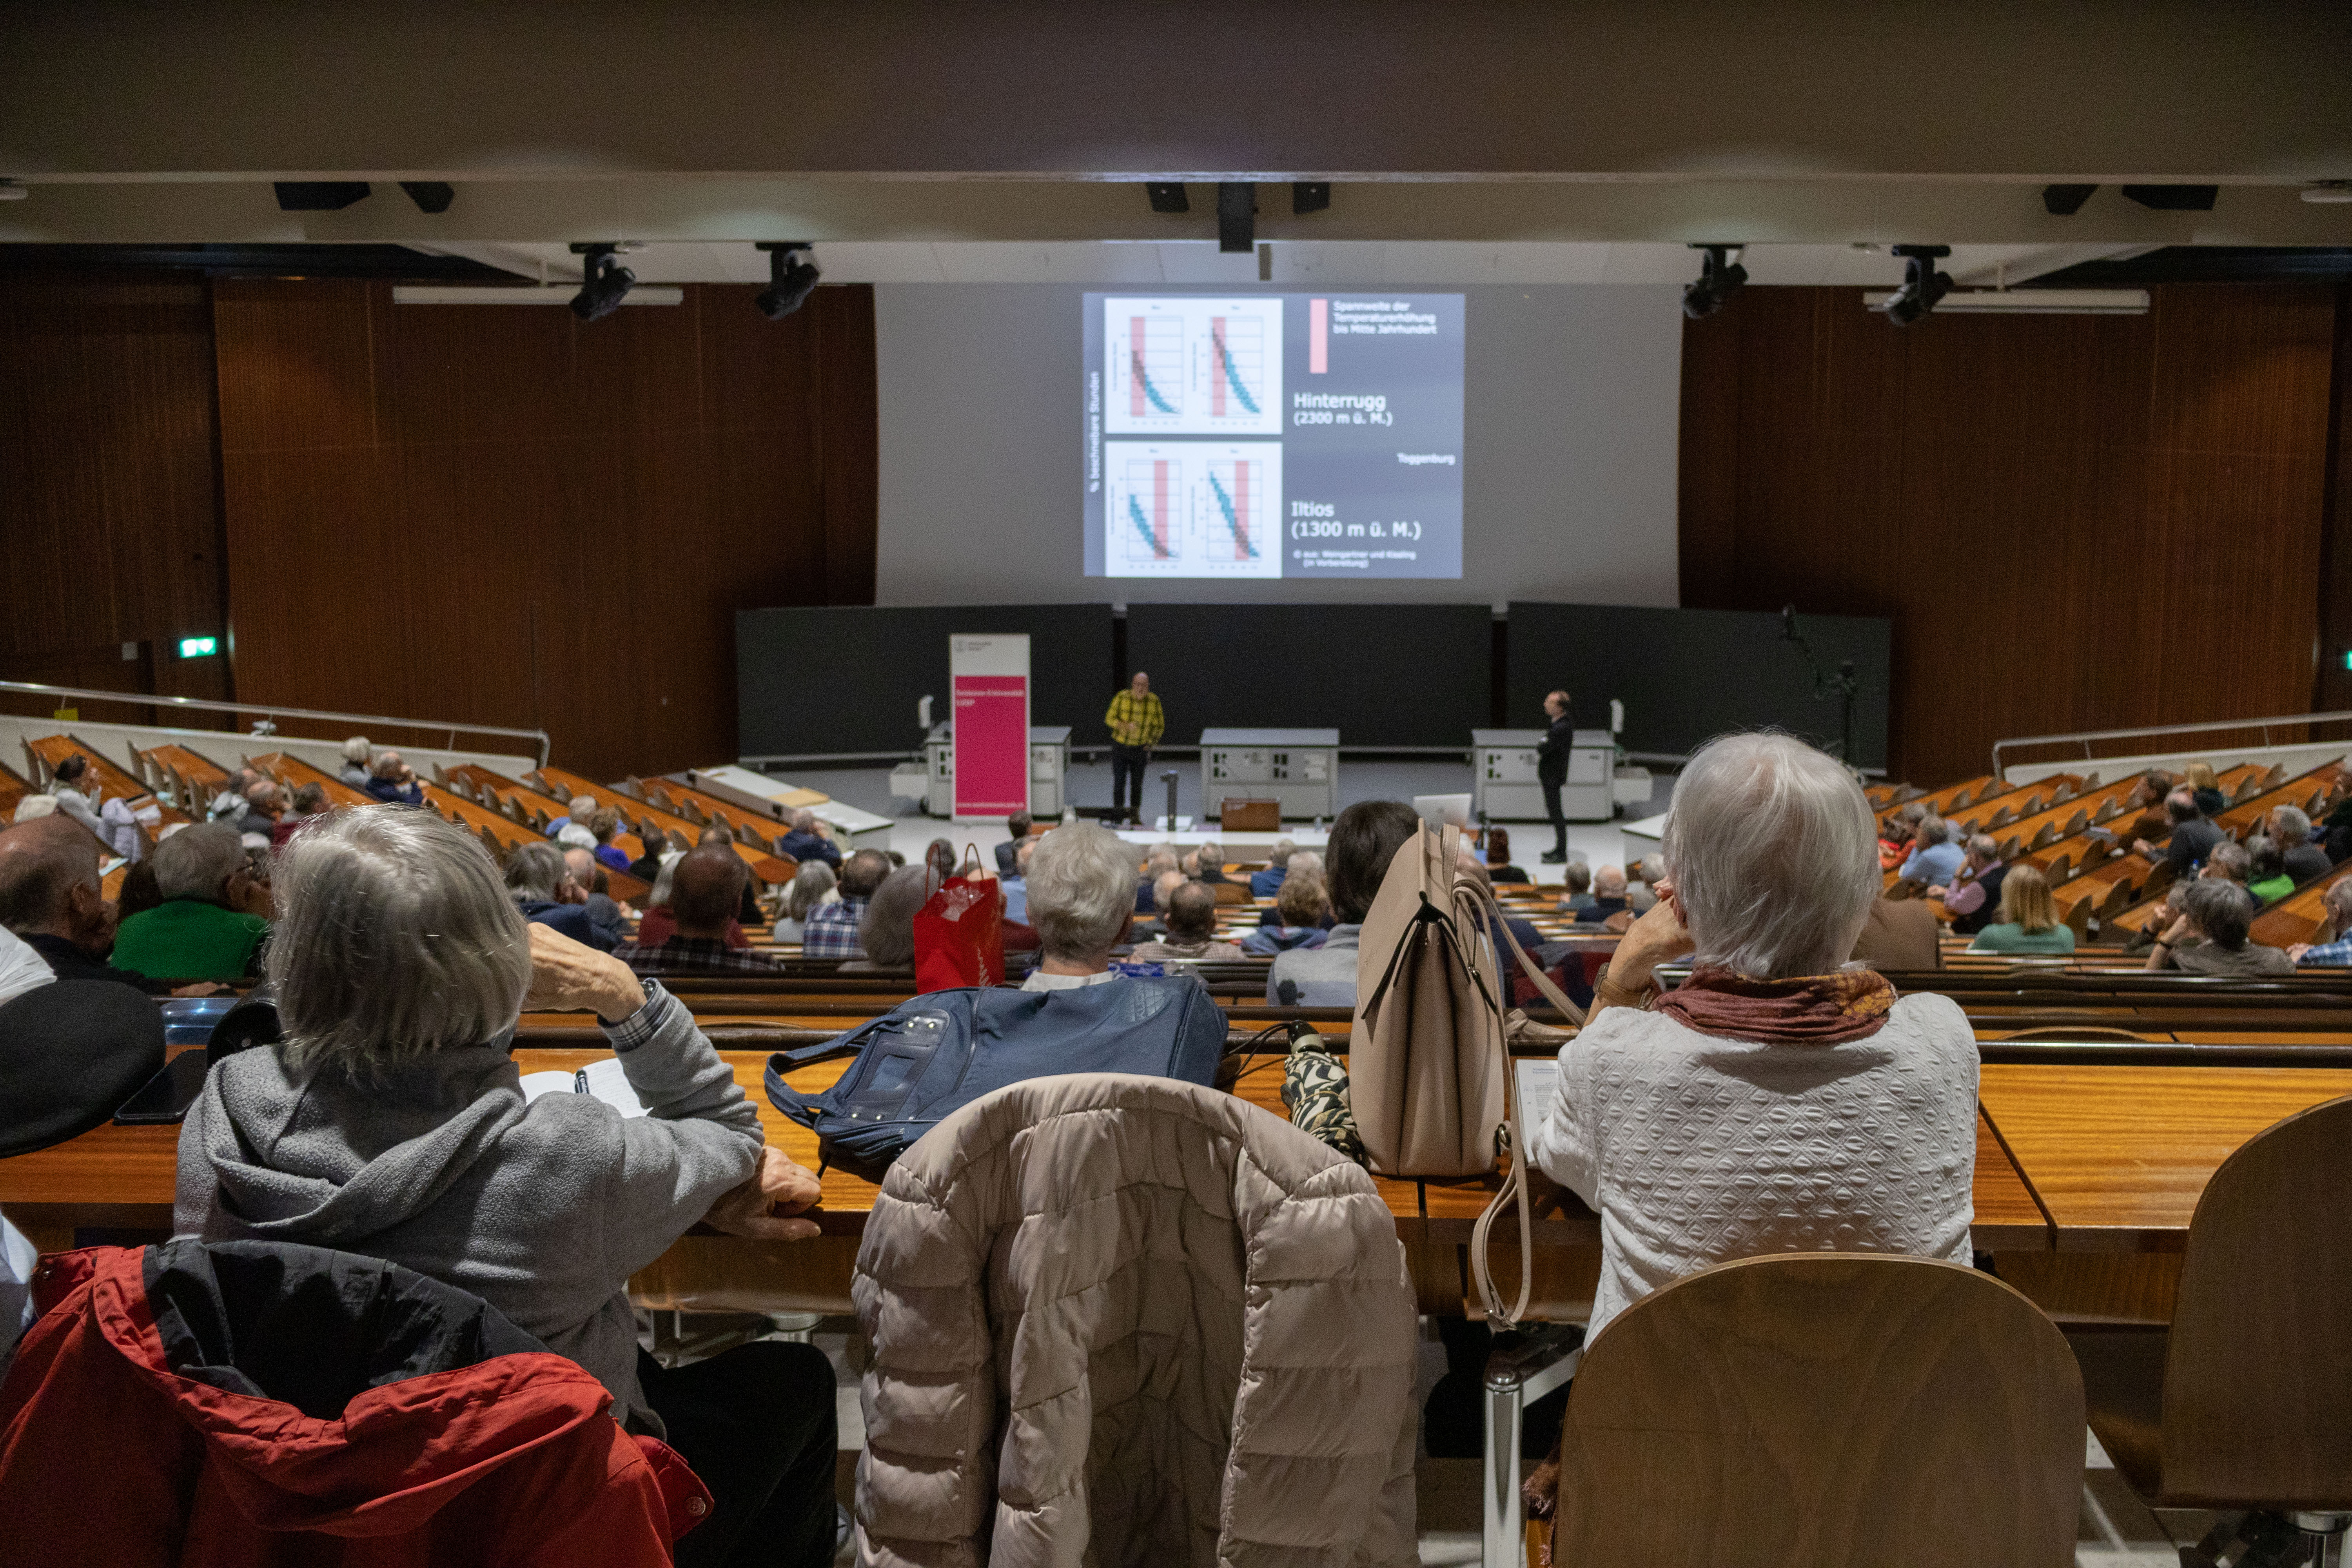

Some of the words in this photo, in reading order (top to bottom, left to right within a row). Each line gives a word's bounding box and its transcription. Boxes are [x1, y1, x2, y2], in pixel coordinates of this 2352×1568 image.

[1392, 301, 1410, 311] der
[1333, 325, 1348, 334] bis
[1350, 325, 1376, 334] Mitte
[1089, 372, 1099, 412] Stunden
[1294, 393, 1386, 412] Hinterrugg
[1294, 412, 1333, 426] (2300
[1336, 414, 1350, 423] m
[1353, 411, 1367, 424] ü.
[1370, 412, 1393, 426] M.)
[1397, 453, 1455, 465] Toggenburg
[1292, 501, 1334, 517] Iltios
[1291, 521, 1343, 539] (1300
[1347, 524, 1365, 536] m
[1370, 521, 1387, 537] ü.
[1392, 521, 1421, 540] M.)
